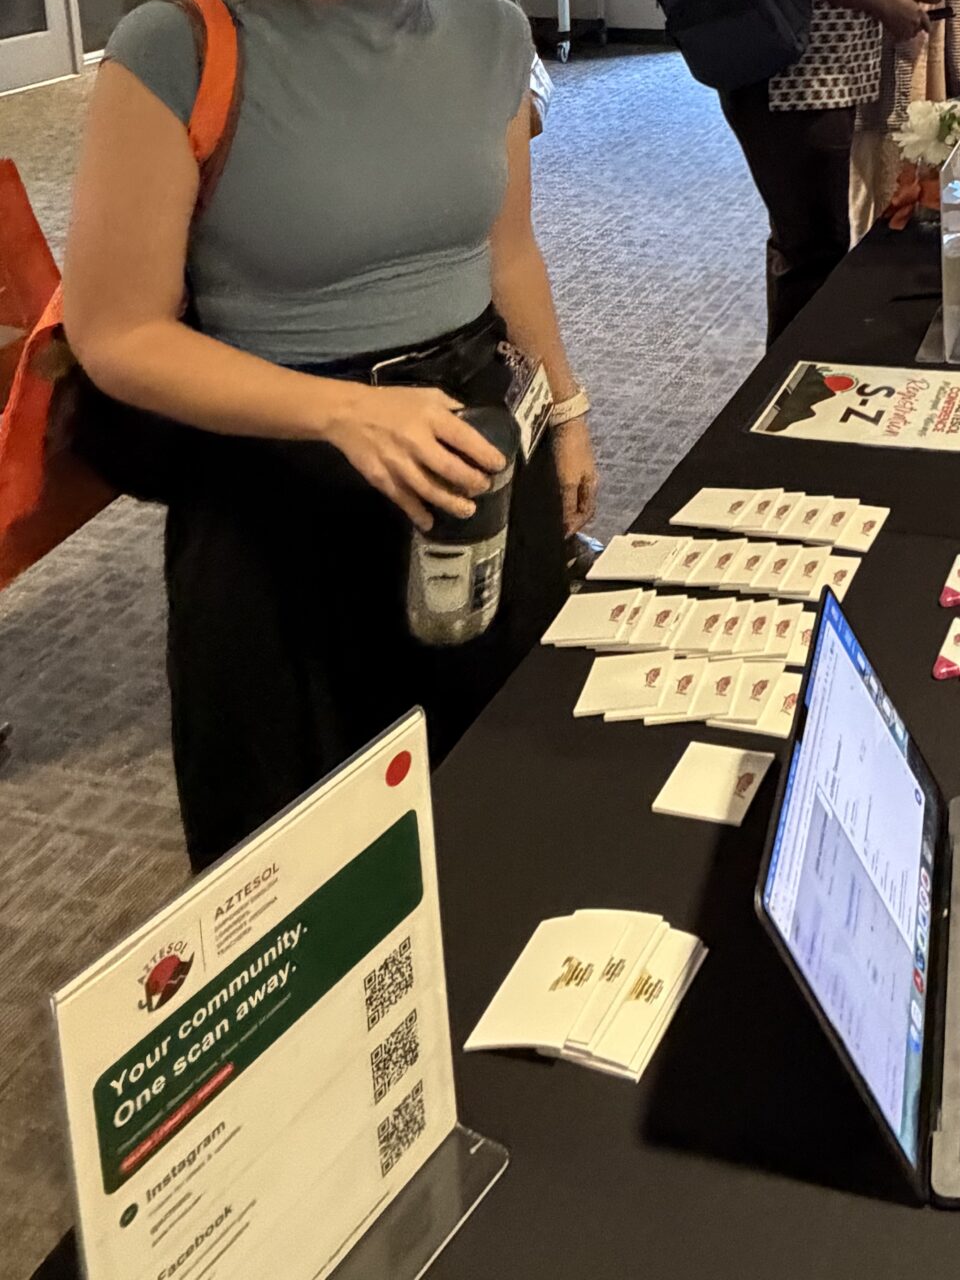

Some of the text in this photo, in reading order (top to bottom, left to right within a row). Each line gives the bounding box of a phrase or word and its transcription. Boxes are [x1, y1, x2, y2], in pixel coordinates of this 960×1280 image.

[838, 383, 896, 427] S-Z
[214, 862, 280, 921] AZTESOL
[109, 1035, 172, 1097] Your
[178, 922, 308, 1040] community.
[113, 1074, 167, 1129] One
[173, 1018, 230, 1077] scan
[236, 961, 297, 1022] away.
[145, 1121, 227, 1203] Instagram
[157, 1203, 233, 1280] Facebook
